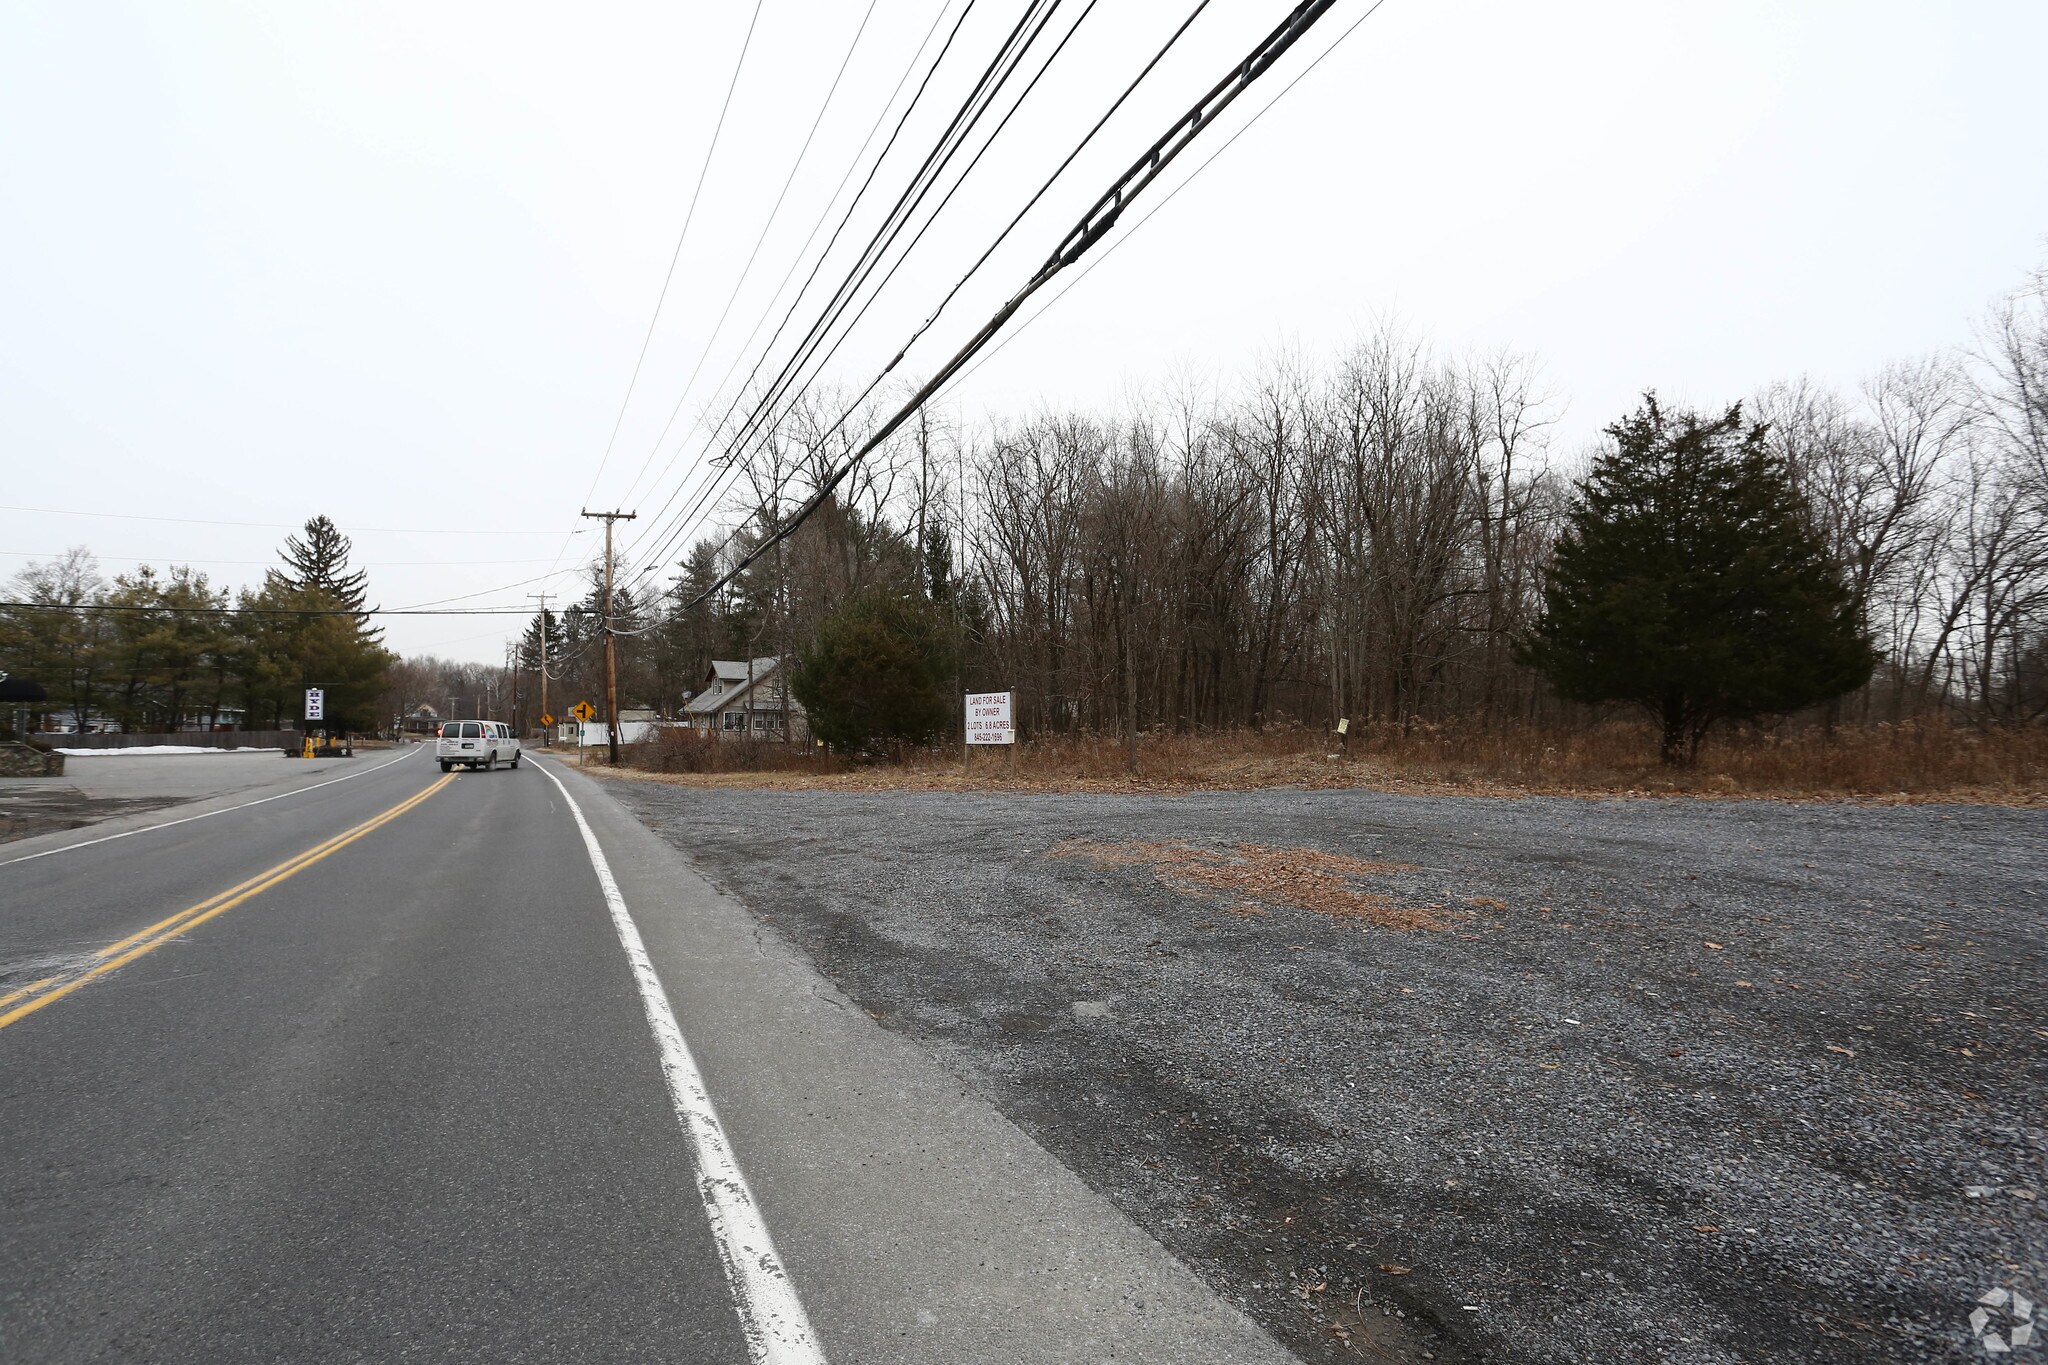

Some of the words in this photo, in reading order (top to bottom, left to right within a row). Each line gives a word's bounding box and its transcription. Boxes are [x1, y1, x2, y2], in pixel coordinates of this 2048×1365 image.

[309, 692, 320, 717] HYDE
[970, 697, 982, 705] LAND
[983, 696, 992, 704] FOR
[993, 695, 1006, 704] SALE
[975, 708, 981, 716] BY
[982, 707, 1000, 716] OWNER
[971, 722, 982, 730] LOTS
[993, 721, 1009, 729] ACRES
